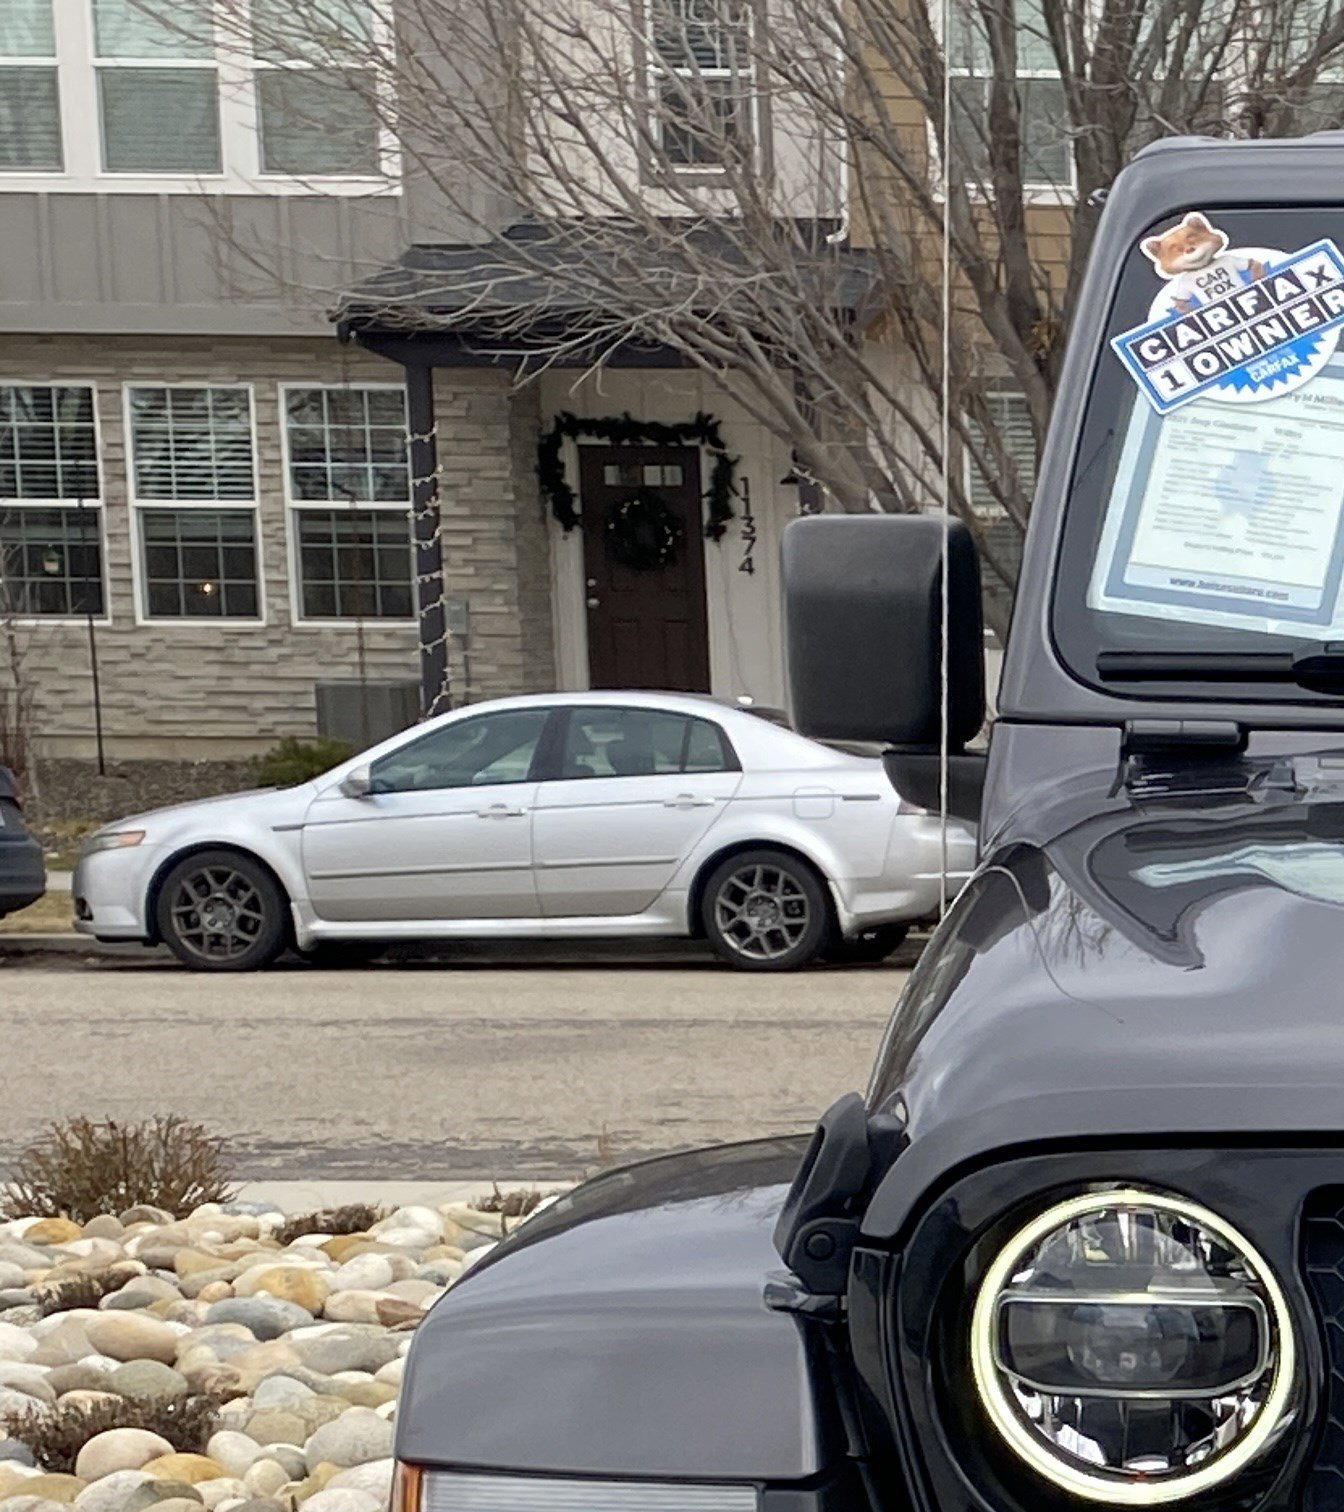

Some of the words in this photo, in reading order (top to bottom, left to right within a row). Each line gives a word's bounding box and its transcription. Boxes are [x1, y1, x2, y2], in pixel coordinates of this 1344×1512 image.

[1195, 267, 1229, 288] CAR
[1203, 279, 1236, 300] FOX
[1138, 264, 1338, 363] CARFAX
[1162, 363, 1184, 392] 1
[738, 477, 757, 576] 11374
